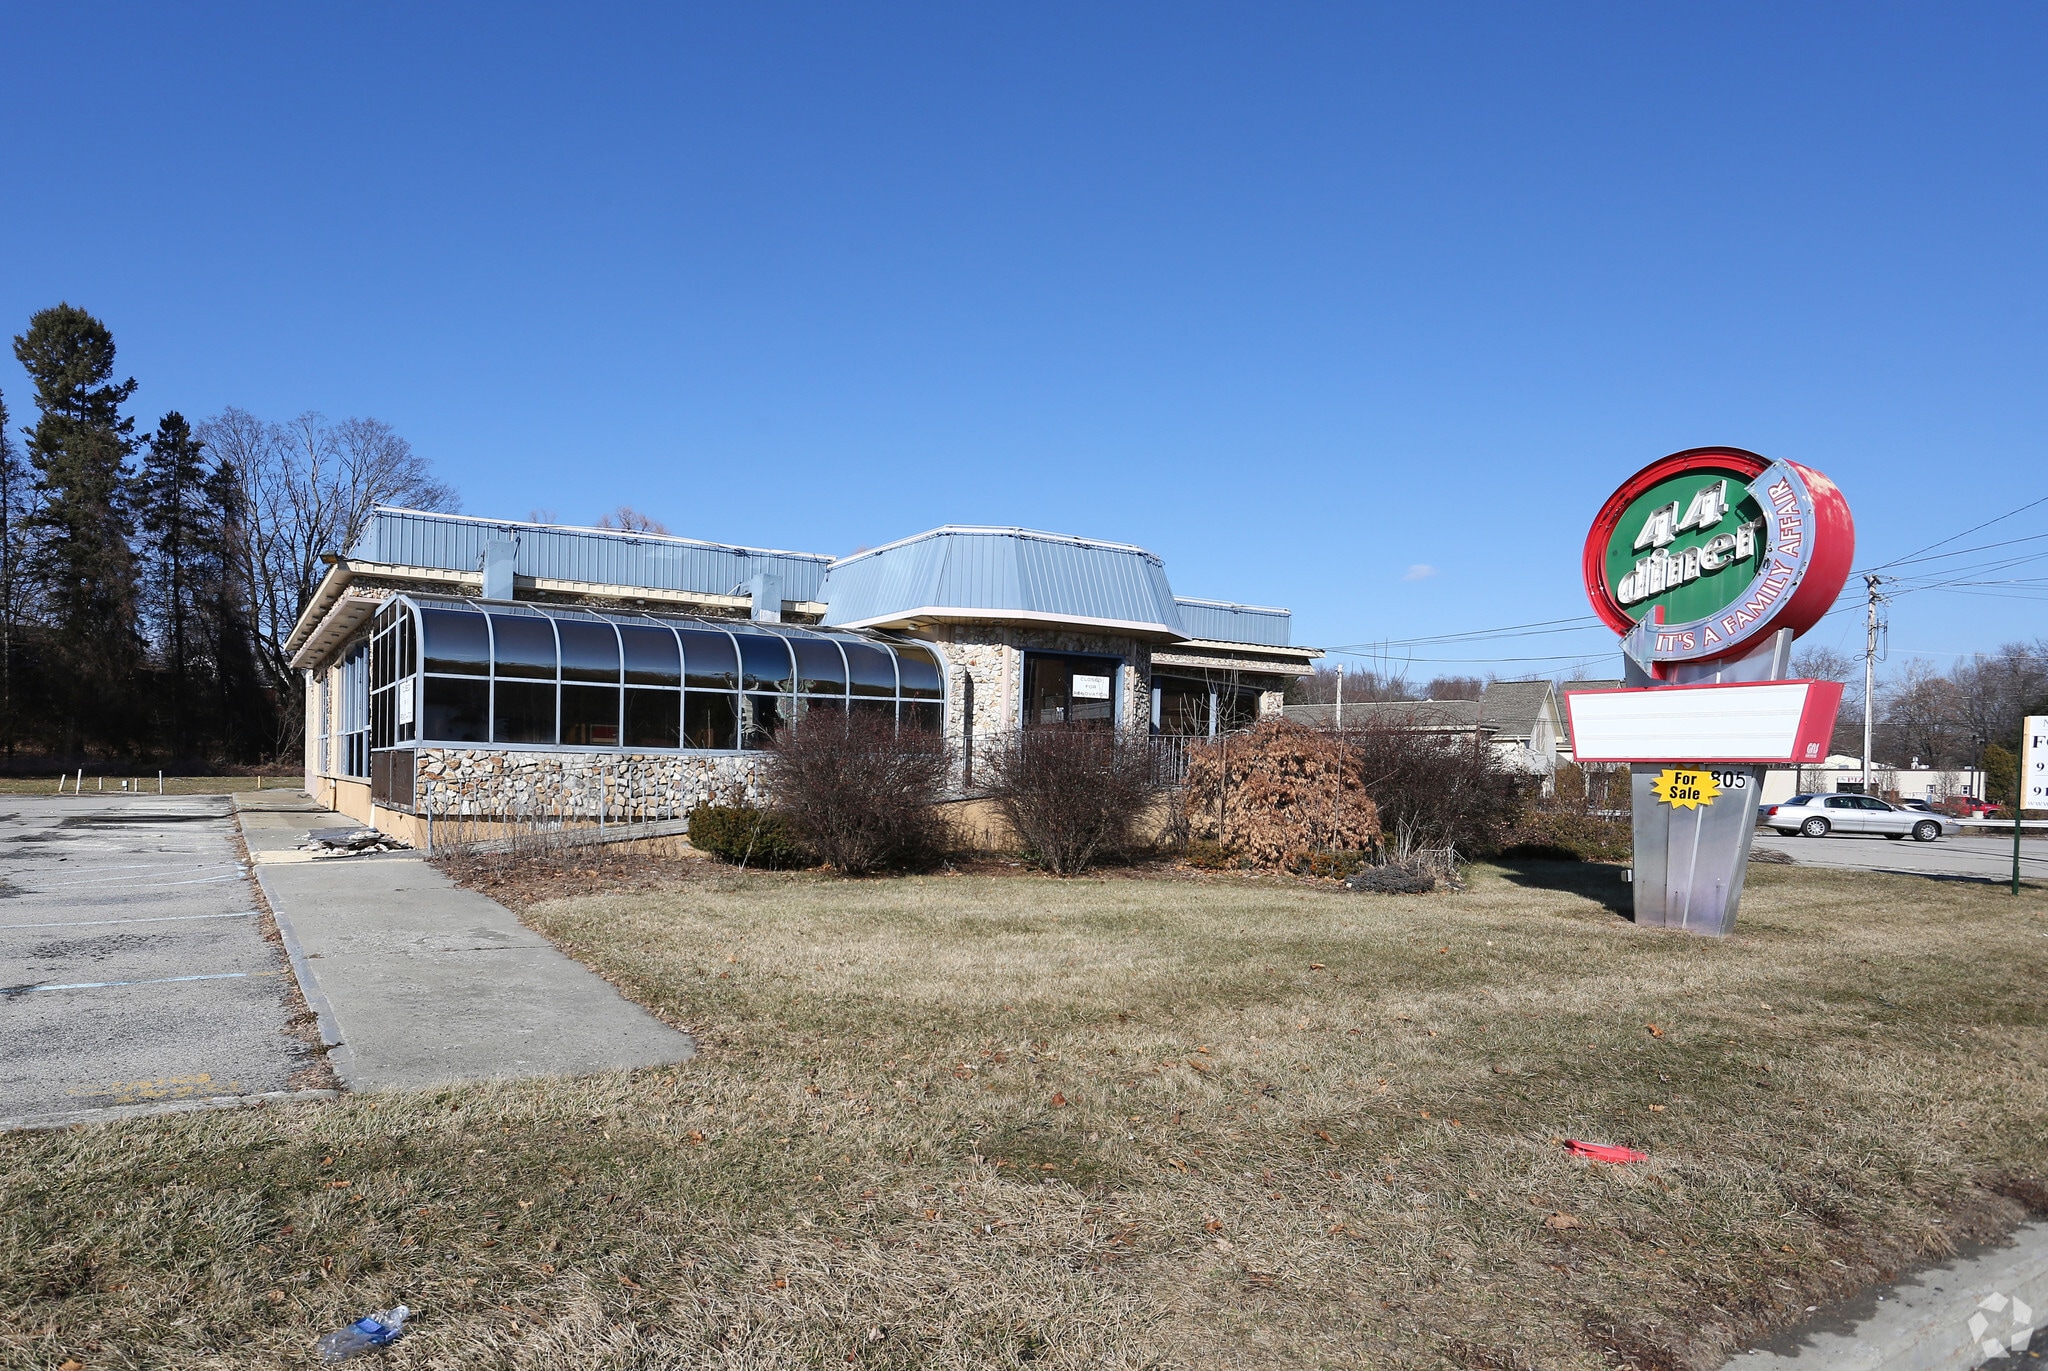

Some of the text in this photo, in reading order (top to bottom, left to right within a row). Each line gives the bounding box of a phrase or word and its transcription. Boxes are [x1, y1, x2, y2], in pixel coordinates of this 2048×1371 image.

[1633, 479, 1730, 550] 44
[1617, 518, 1762, 604] diner
[1655, 476, 1803, 652] IT'S A FAMILY AFFAIR
[1669, 786, 1700, 800] Sale
[1674, 772, 1697, 785] For
[1711, 770, 1746, 788] 805
